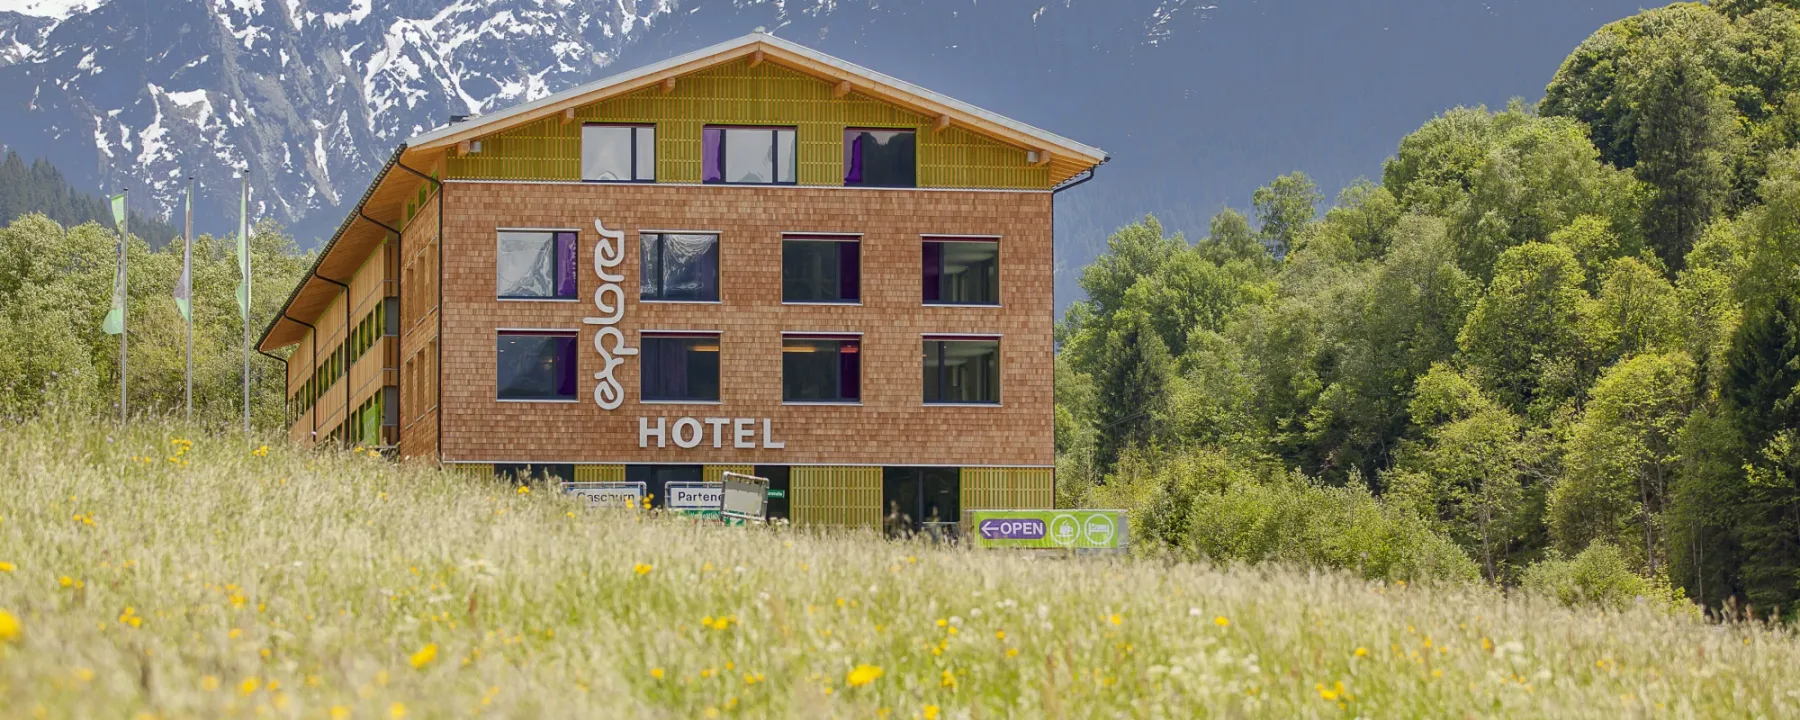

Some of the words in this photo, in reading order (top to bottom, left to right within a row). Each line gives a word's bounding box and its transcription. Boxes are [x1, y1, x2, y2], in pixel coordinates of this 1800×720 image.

[582, 218, 639, 411] explorer
[638, 416, 785, 449] HOTEL
[1000, 522, 1044, 536] OPEN
